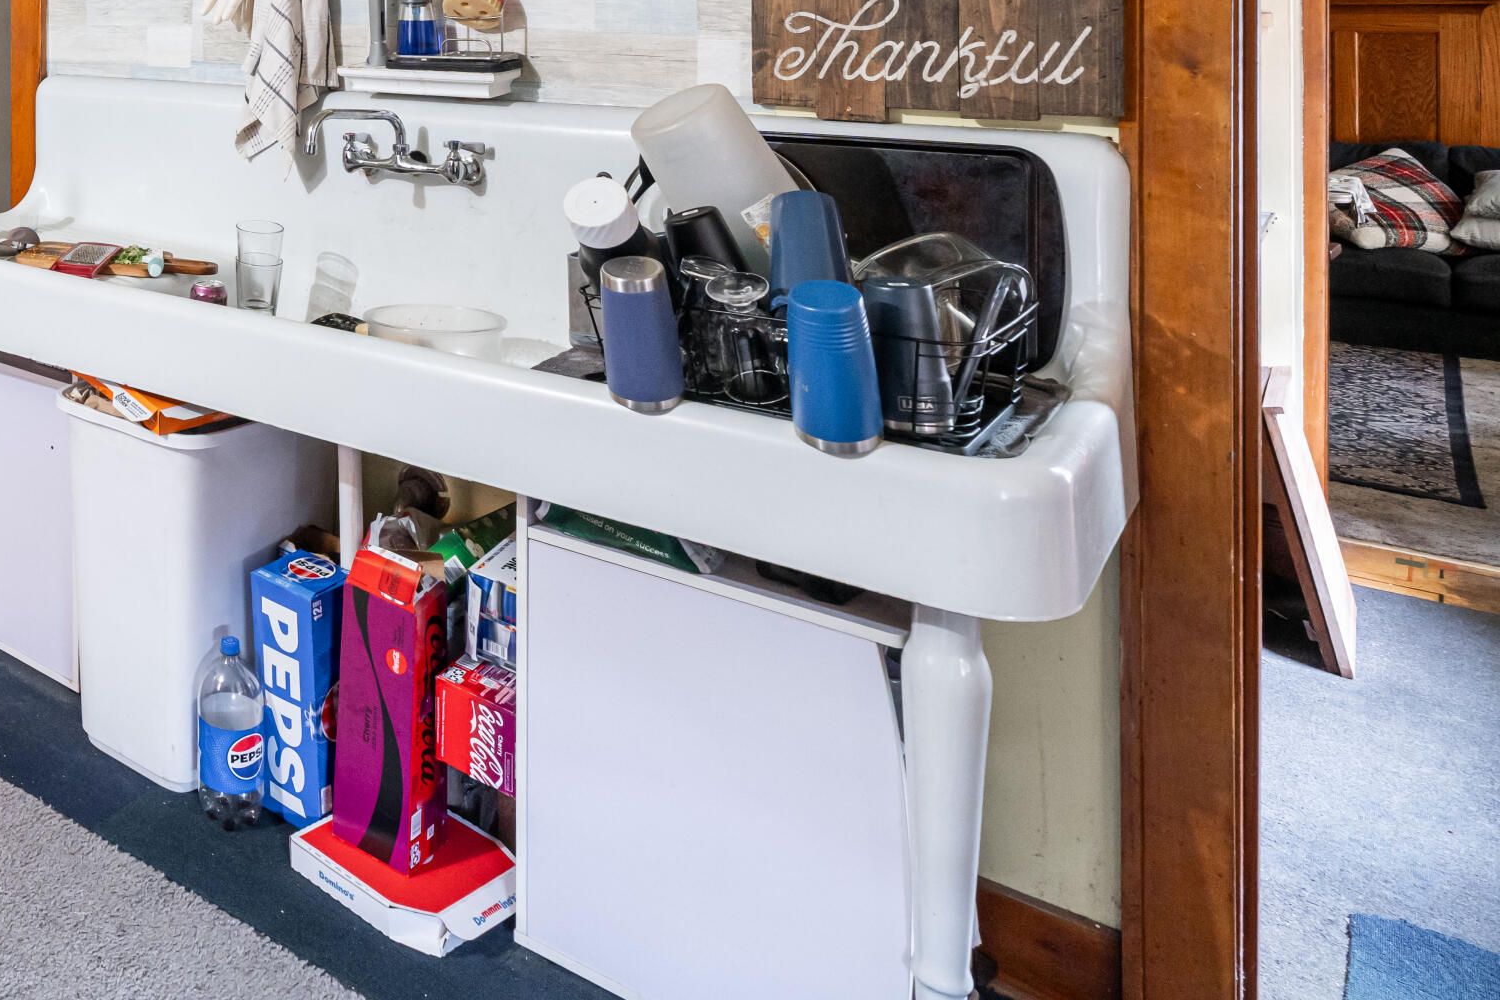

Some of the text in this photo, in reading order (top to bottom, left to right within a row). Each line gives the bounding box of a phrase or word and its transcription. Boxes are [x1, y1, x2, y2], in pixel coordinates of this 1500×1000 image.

[579, 511, 604, 529] cused
[604, 524, 616, 535] on
[616, 529, 635, 544] your
[261, 595, 308, 819] PEPSI
[318, 870, 355, 902] Domino's
